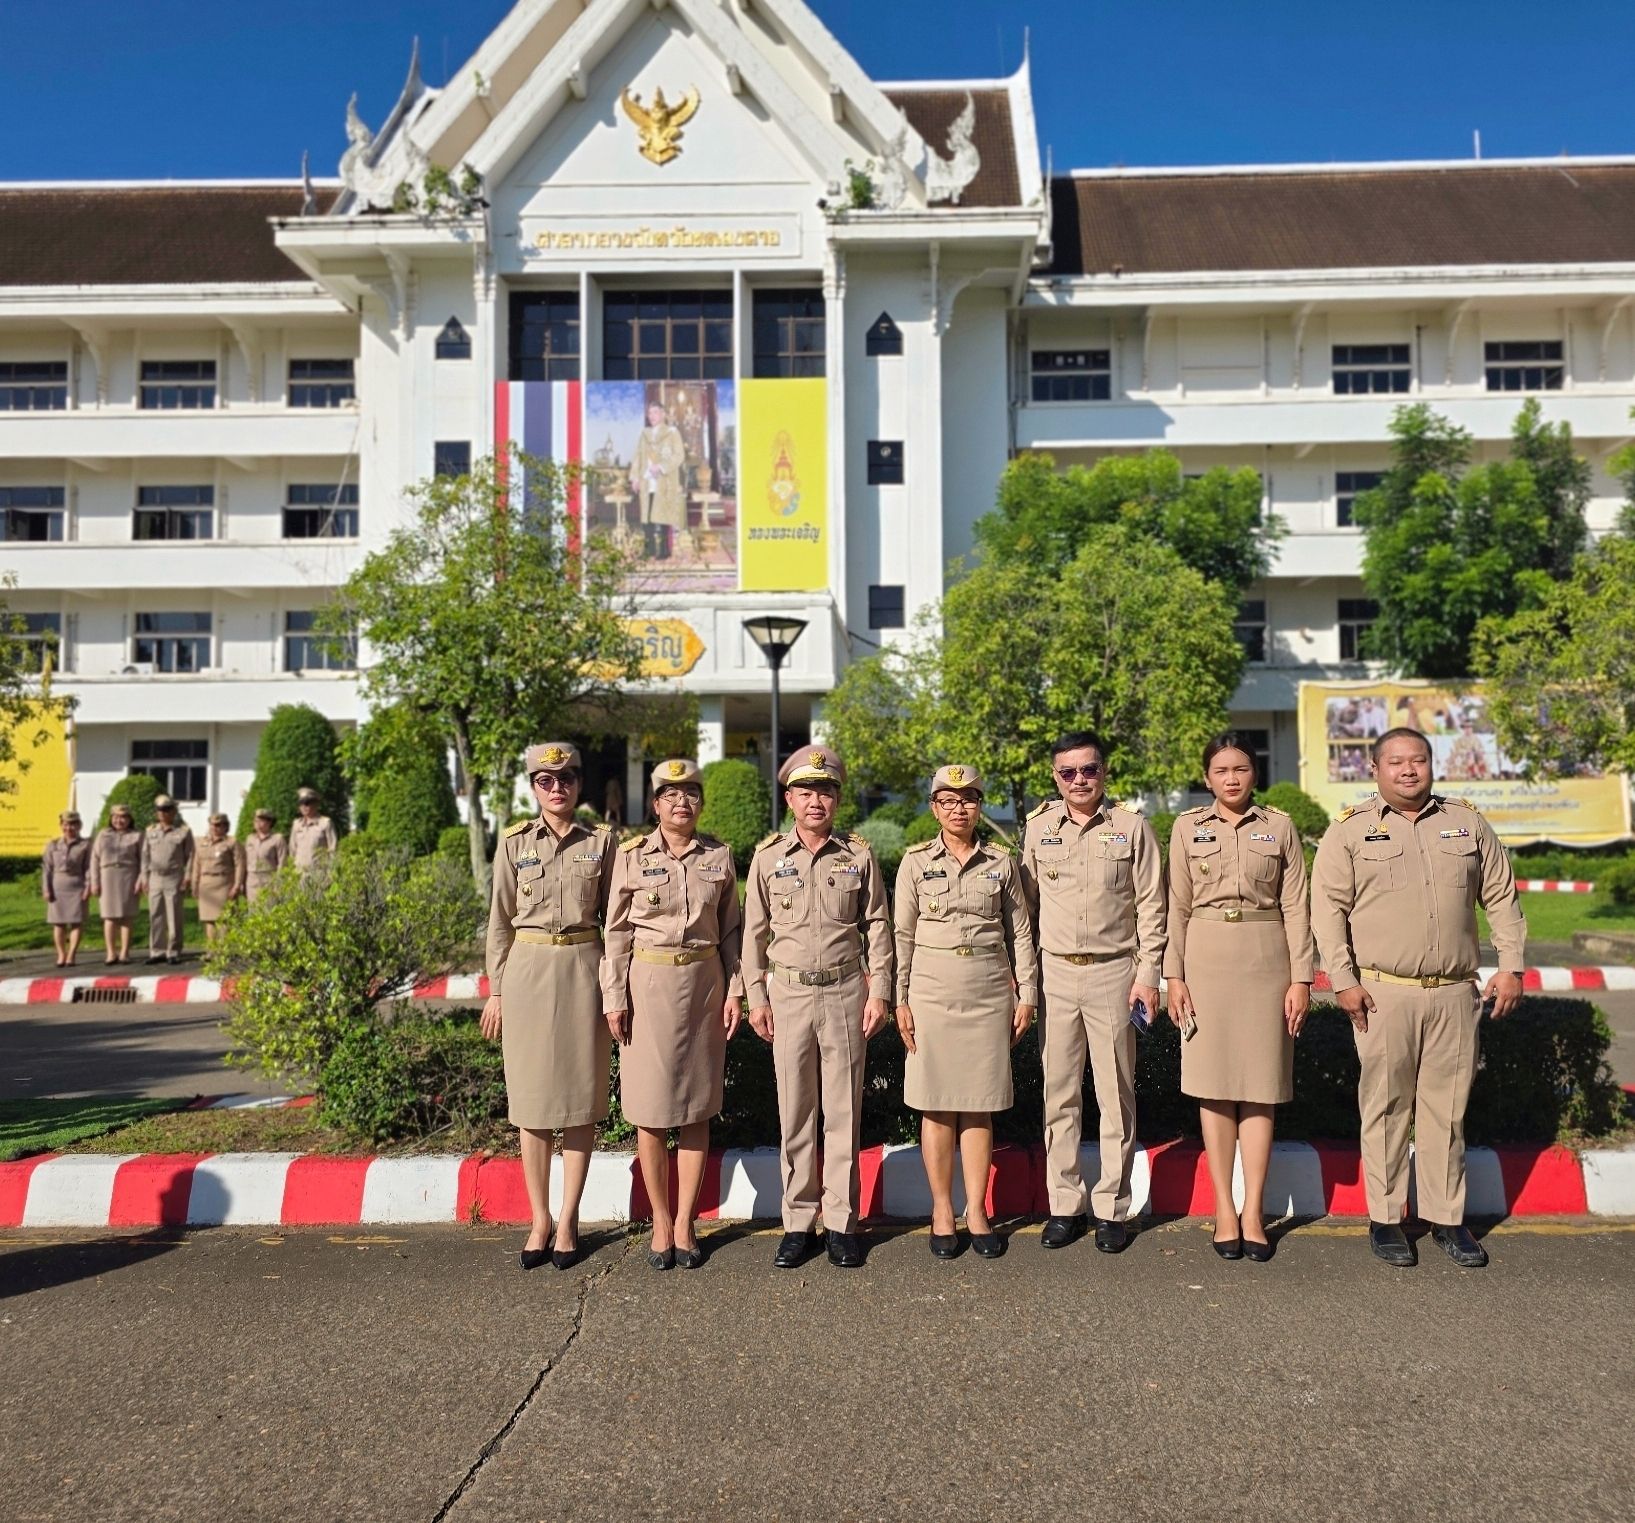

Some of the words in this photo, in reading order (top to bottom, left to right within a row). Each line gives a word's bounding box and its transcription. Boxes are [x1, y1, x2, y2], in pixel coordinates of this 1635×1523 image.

[748, 522, 820, 544] ทรงพระเจริญ
